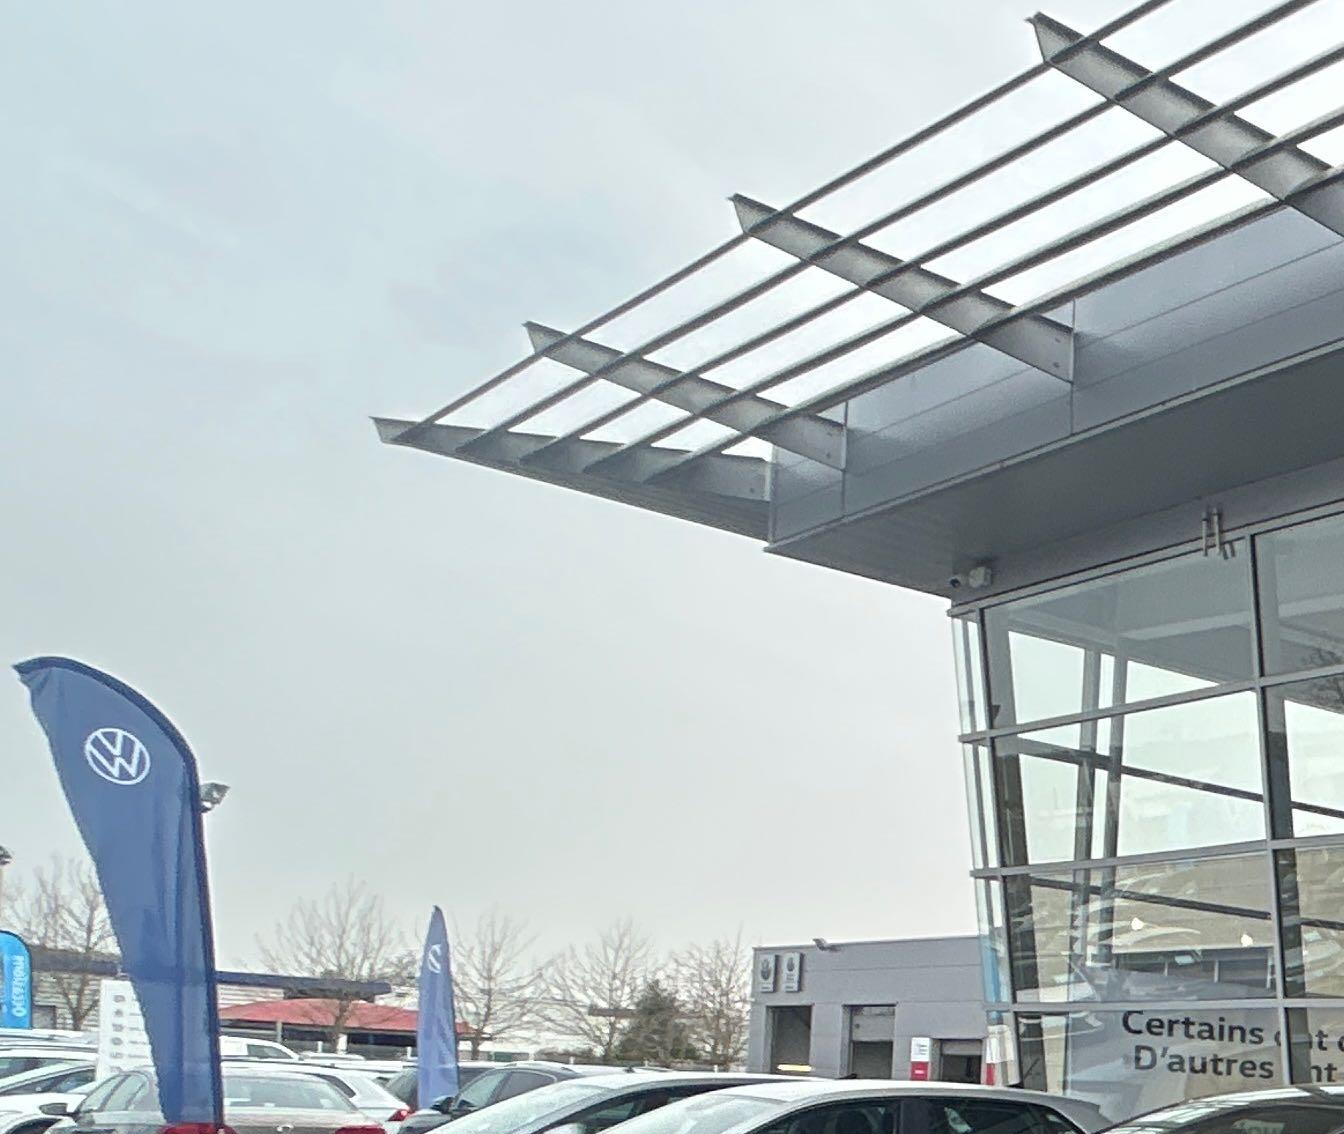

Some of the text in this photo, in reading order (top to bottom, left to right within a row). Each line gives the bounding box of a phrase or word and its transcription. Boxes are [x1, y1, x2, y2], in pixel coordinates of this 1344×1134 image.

[86, 728, 149, 783] VW
[1122, 1010, 1264, 1045] Certains
[1134, 1044, 1274, 1079] D'autres
